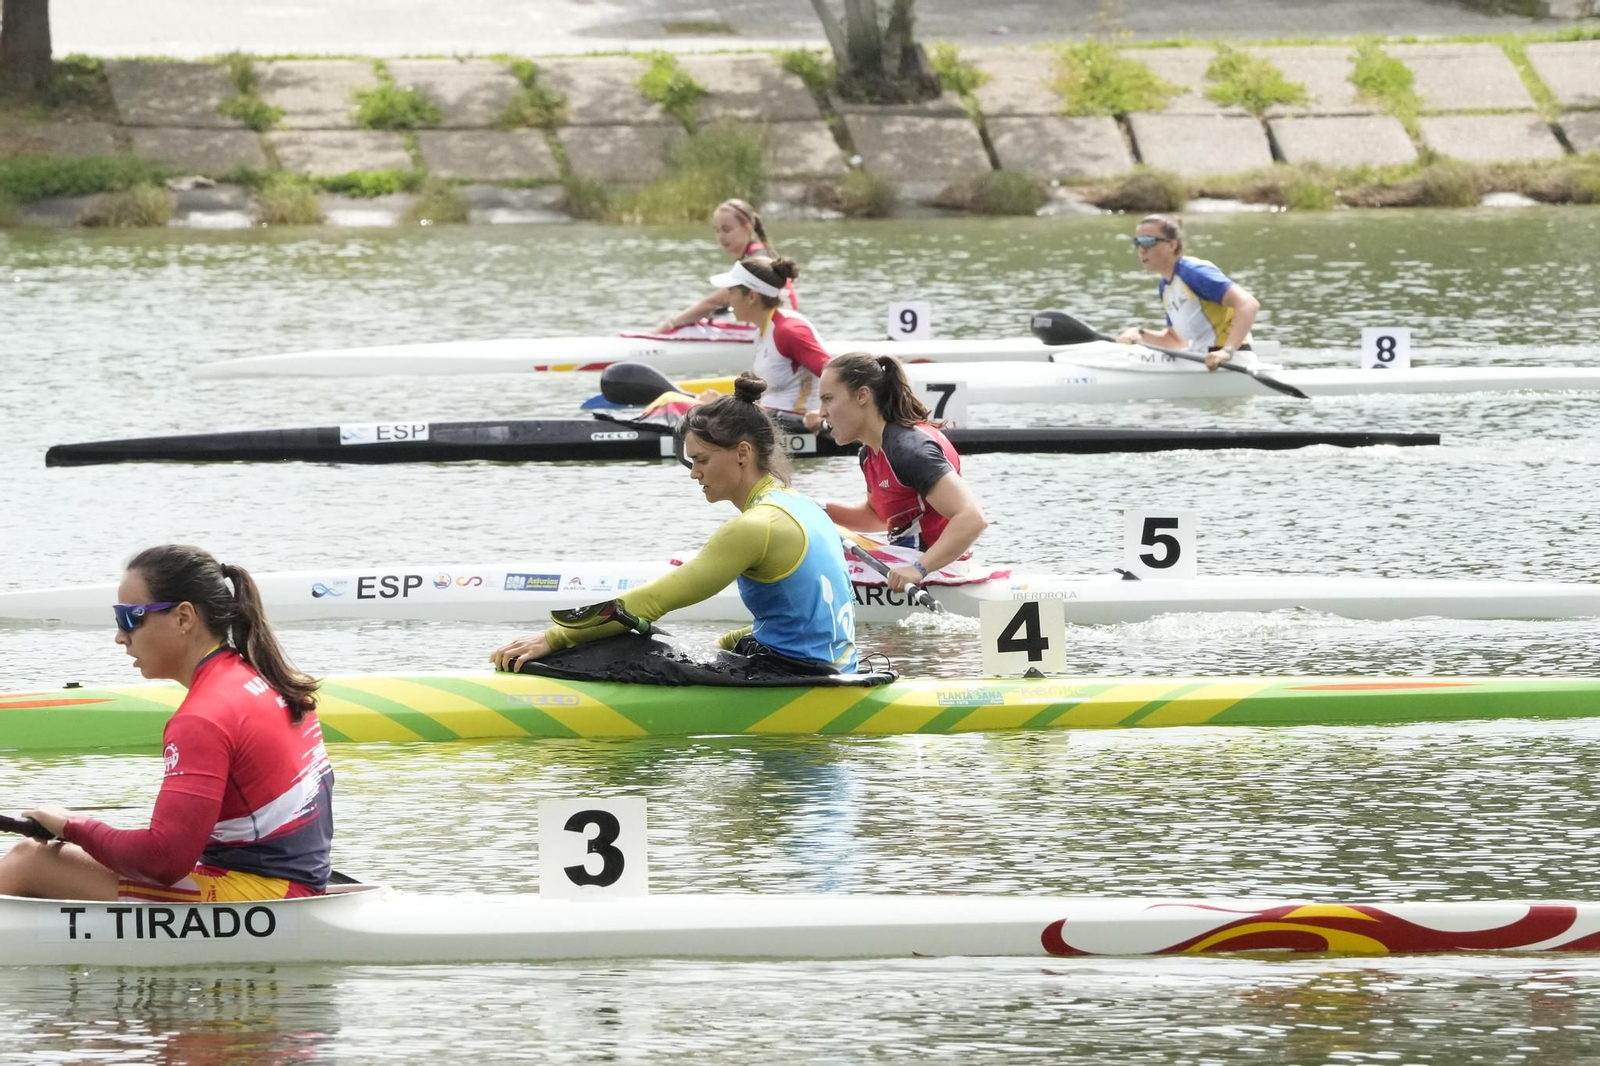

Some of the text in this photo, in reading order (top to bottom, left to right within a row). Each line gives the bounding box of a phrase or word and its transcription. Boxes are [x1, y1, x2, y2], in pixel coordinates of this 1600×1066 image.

[899, 309, 918, 334] 9
[1376, 335, 1396, 362] 8
[926, 383, 956, 419] 7
[376, 424, 426, 441] ESP
[1139, 517, 1181, 569] 5
[357, 574, 423, 600] ESP
[1012, 591, 1078, 600] IBERDROLA
[997, 601, 1049, 662] 4
[937, 691, 1003, 700] PLANTA SANA
[563, 809, 625, 888] 3
[60, 905, 277, 940] T. TIRADO
